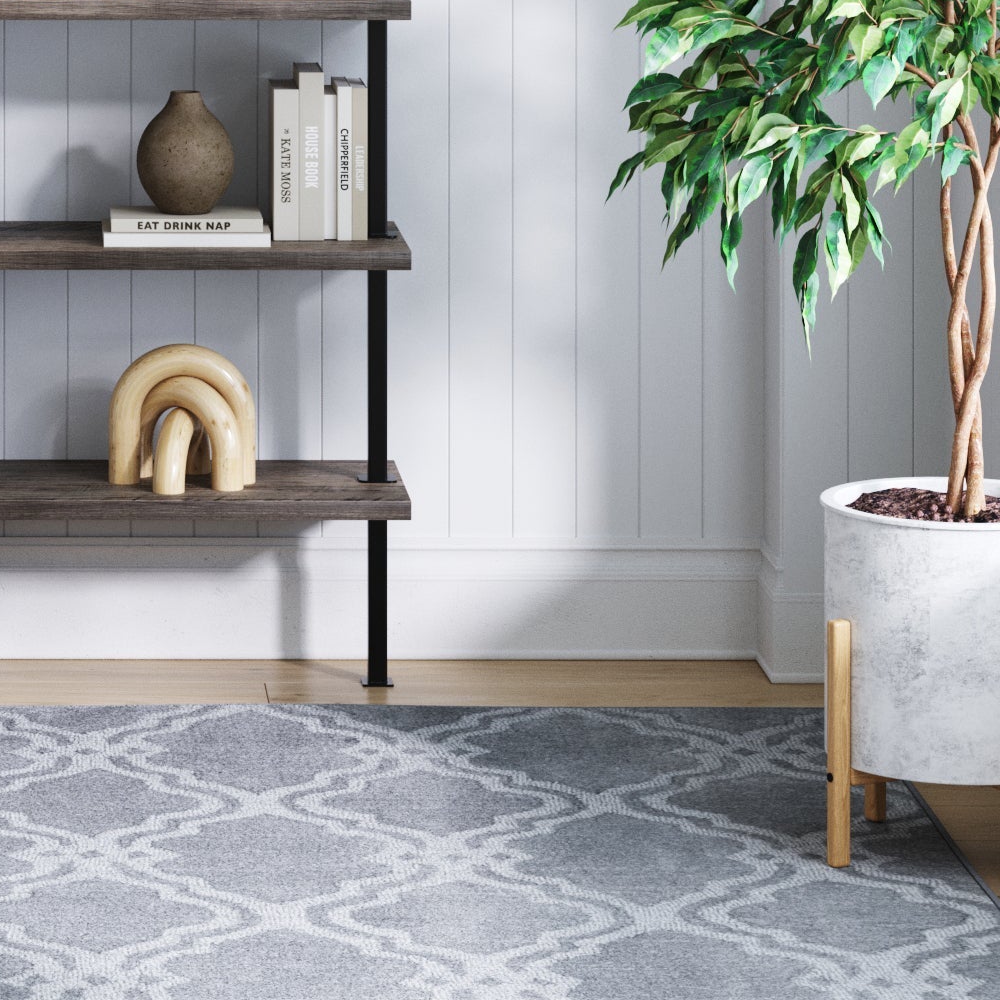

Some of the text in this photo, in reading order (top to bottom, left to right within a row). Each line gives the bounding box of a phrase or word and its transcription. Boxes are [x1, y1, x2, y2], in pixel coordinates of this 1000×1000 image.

[281, 138, 291, 168] KATE
[305, 126, 319, 189] HOUSE BOOK
[340, 128, 349, 191] CHIPPERFIELD
[355, 145, 365, 192] LEADERSHIP
[281, 172, 291, 203] MOSS
[137, 221, 231, 231] EAT DRINK NAP
